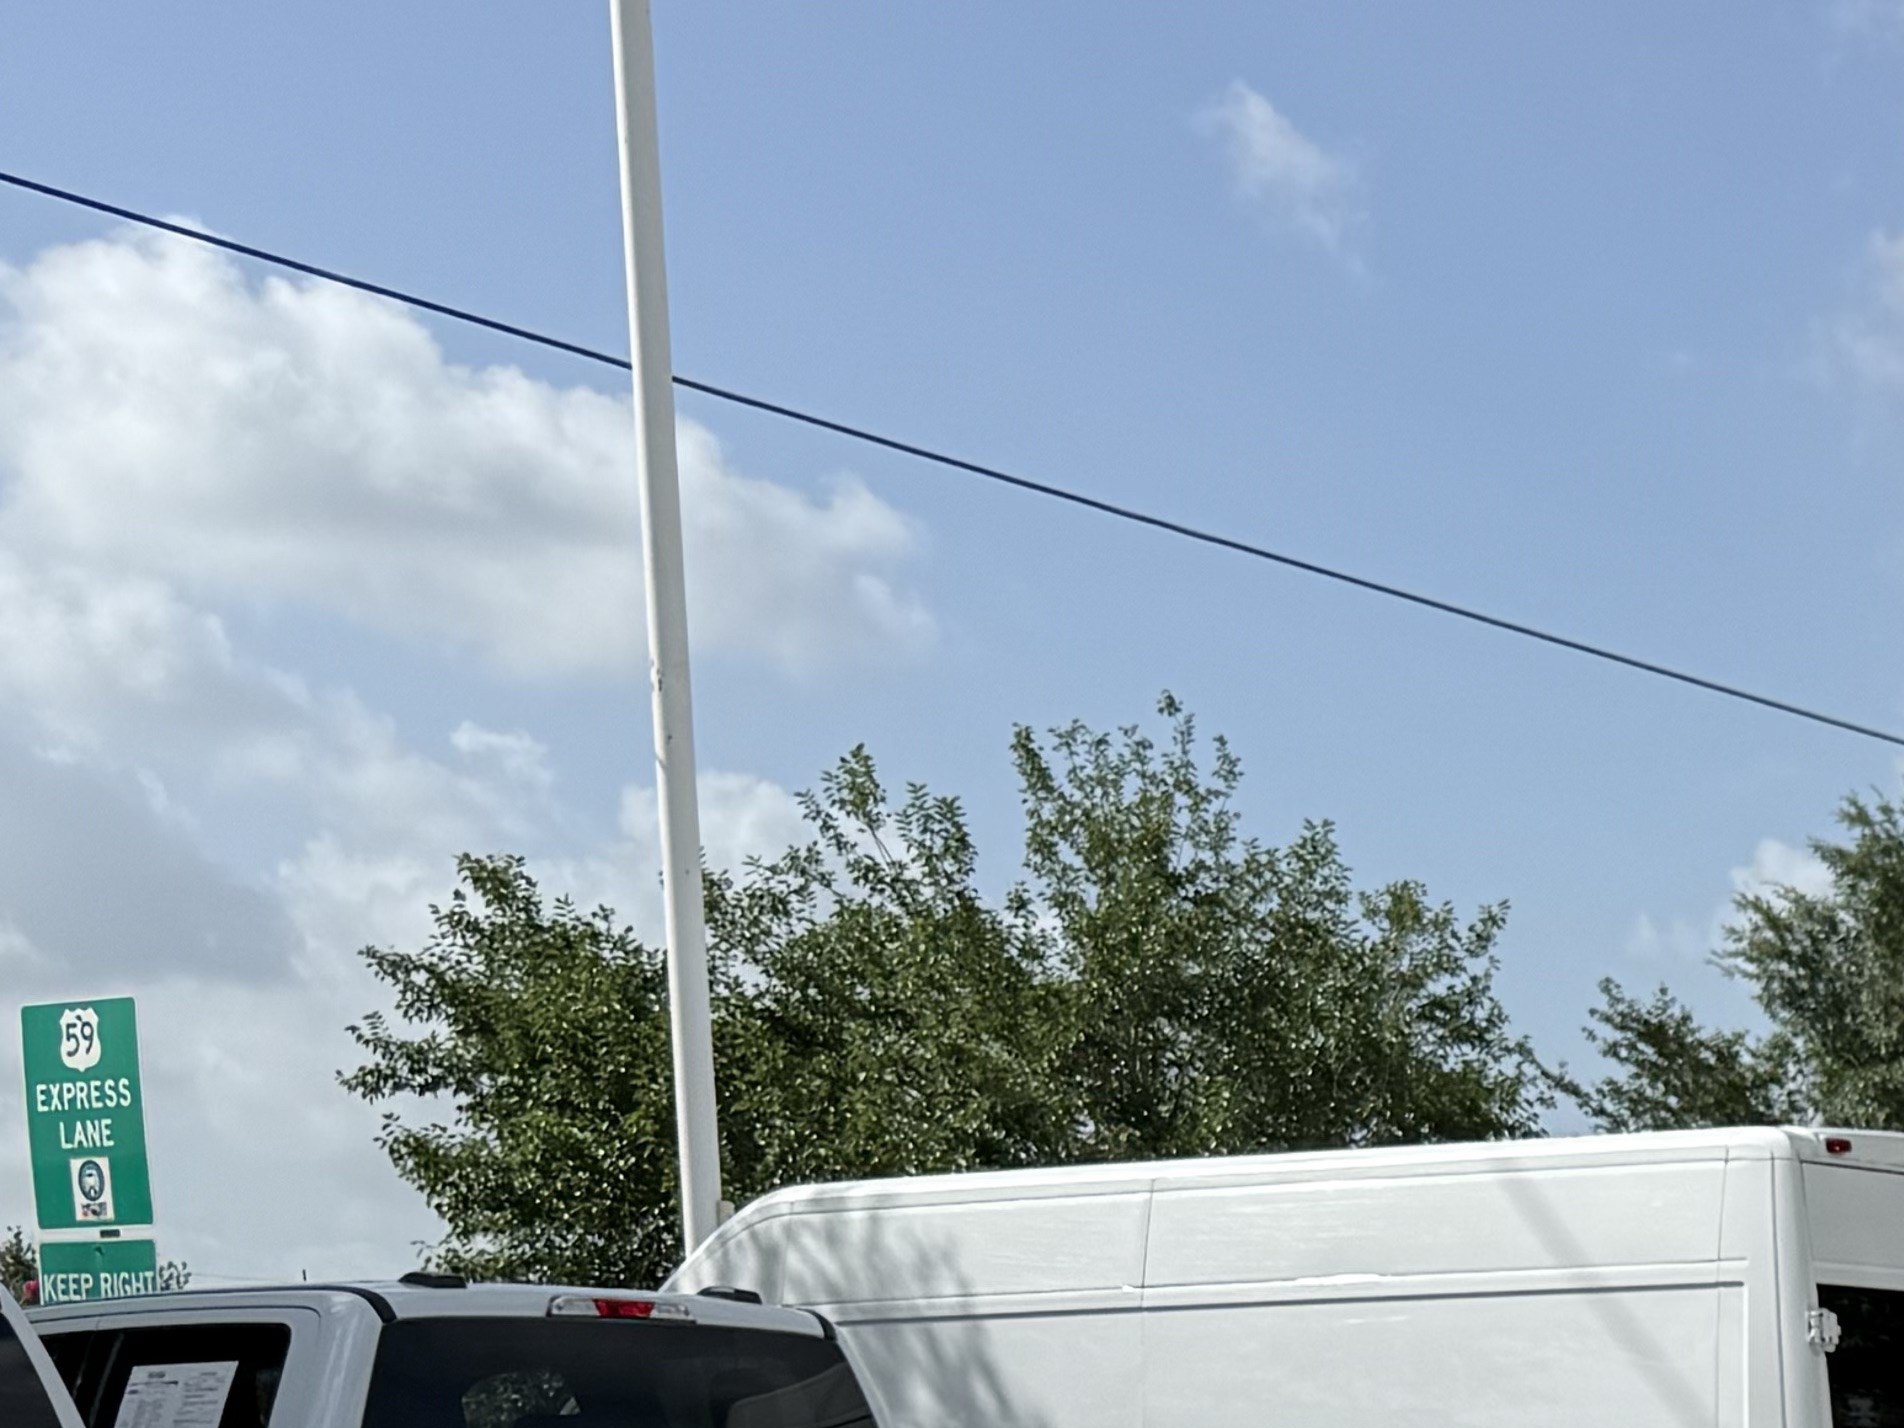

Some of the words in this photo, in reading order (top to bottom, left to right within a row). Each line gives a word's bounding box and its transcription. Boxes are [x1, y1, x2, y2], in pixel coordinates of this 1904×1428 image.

[65, 1020, 96, 1058] 59
[36, 1078, 132, 1113] EXPRESS
[58, 1118, 116, 1150] LANE
[42, 1272, 94, 1302] KEEP
[99, 1270, 155, 1298] RIGHT
